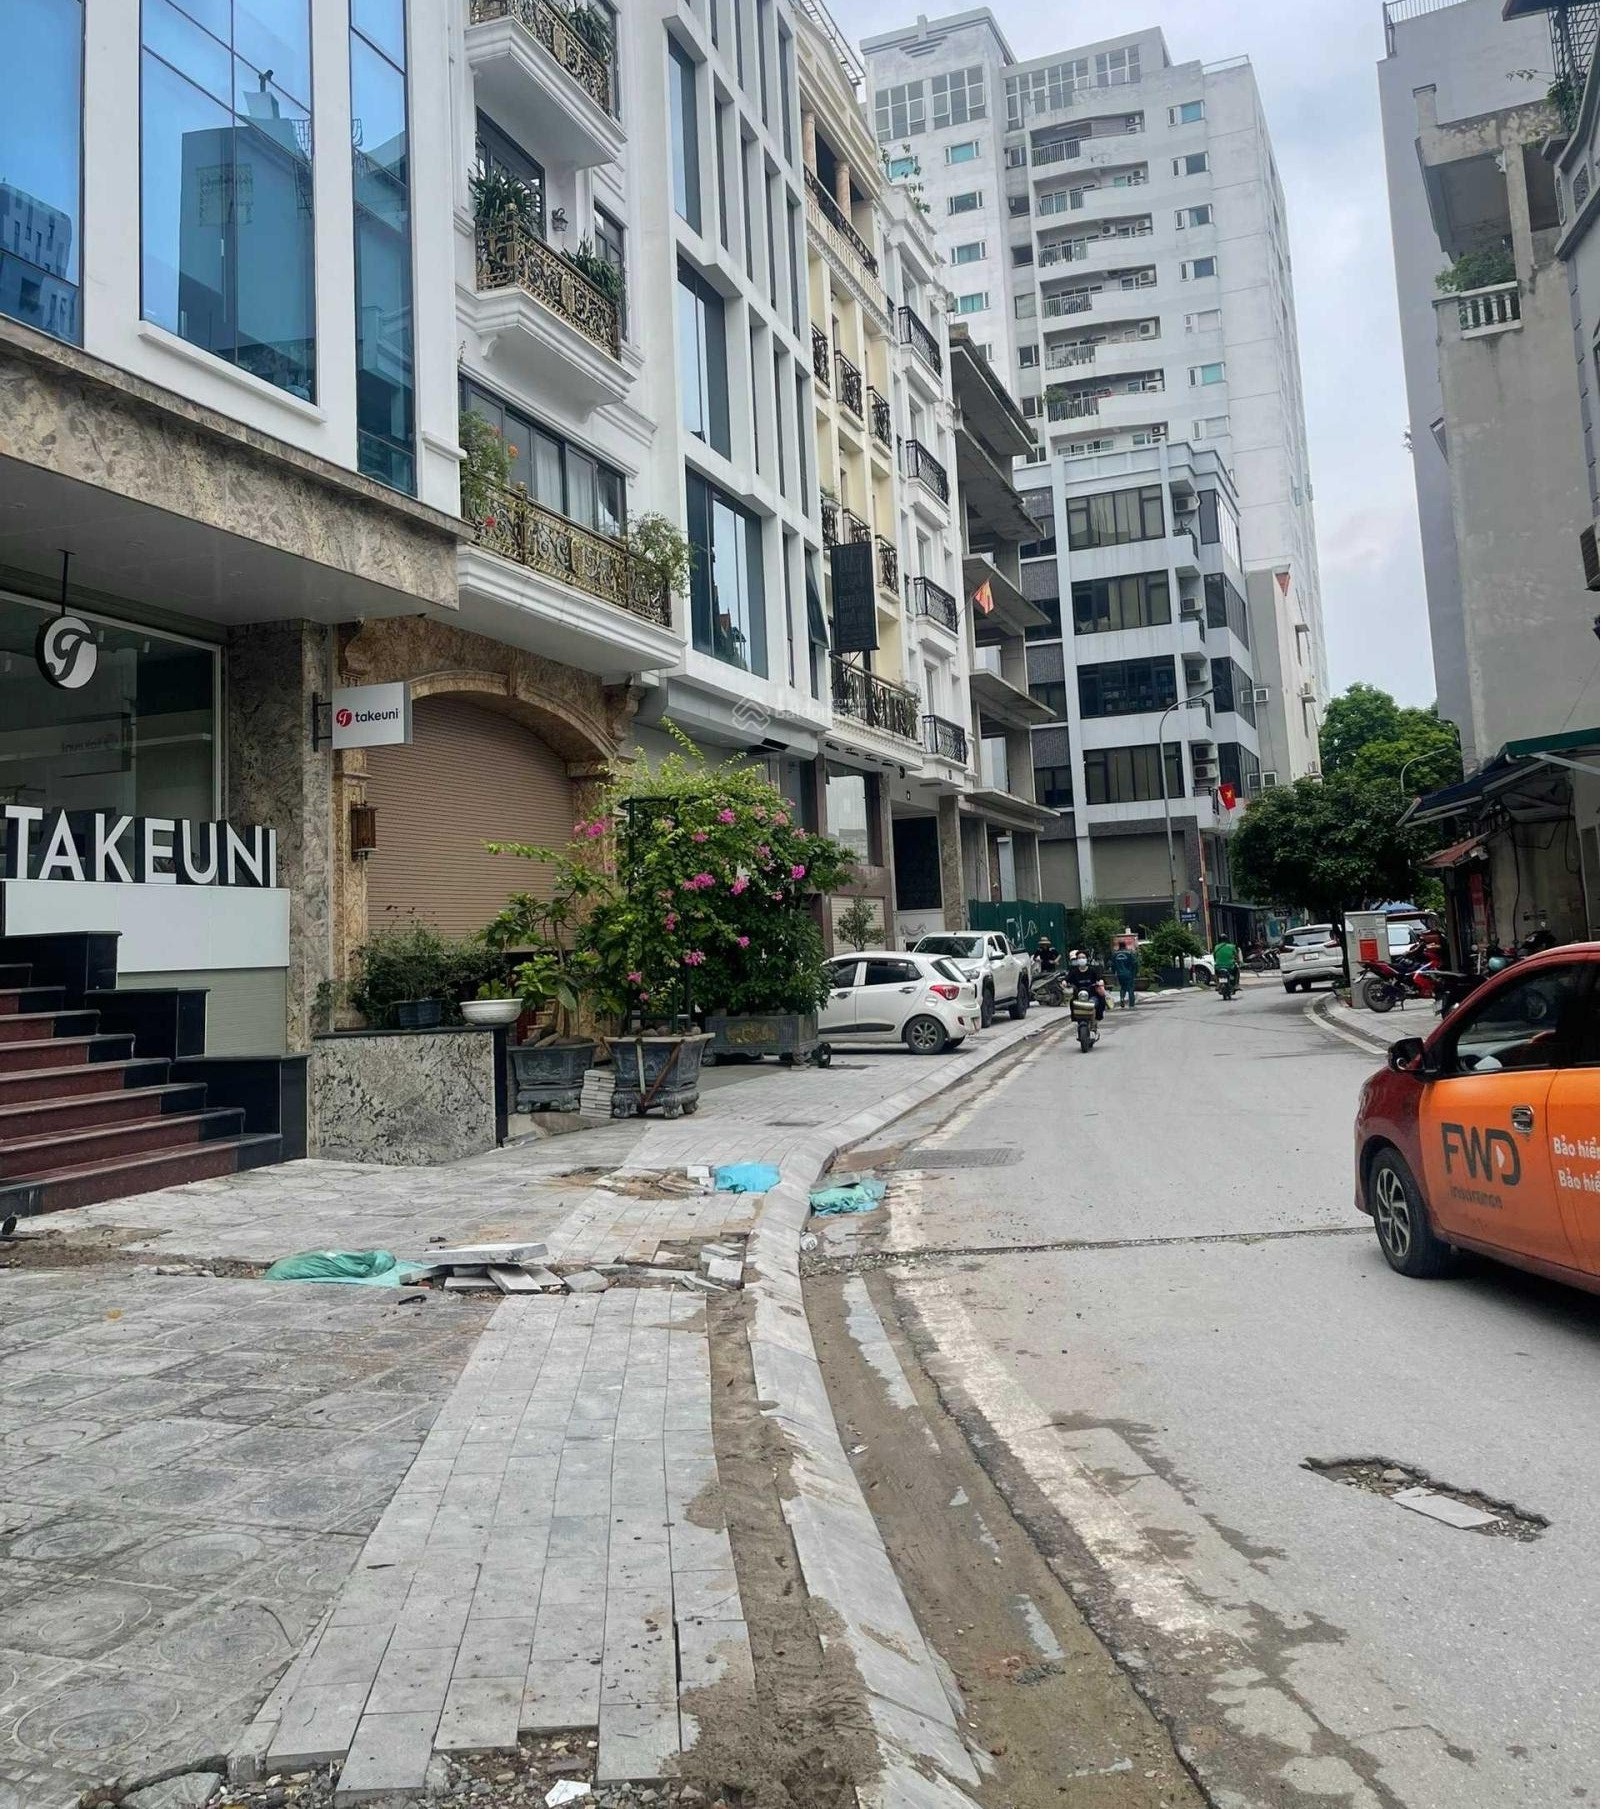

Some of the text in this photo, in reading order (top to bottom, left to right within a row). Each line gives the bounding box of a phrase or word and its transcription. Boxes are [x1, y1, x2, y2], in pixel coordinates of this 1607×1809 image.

[355, 708, 399, 722] takeuni
[4, 804, 277, 887] TAKEUNI
[1441, 1122, 1521, 1186] FWD
[1553, 1135, 1575, 1156] Bảo
[1558, 1168, 1581, 1189] Bảo
